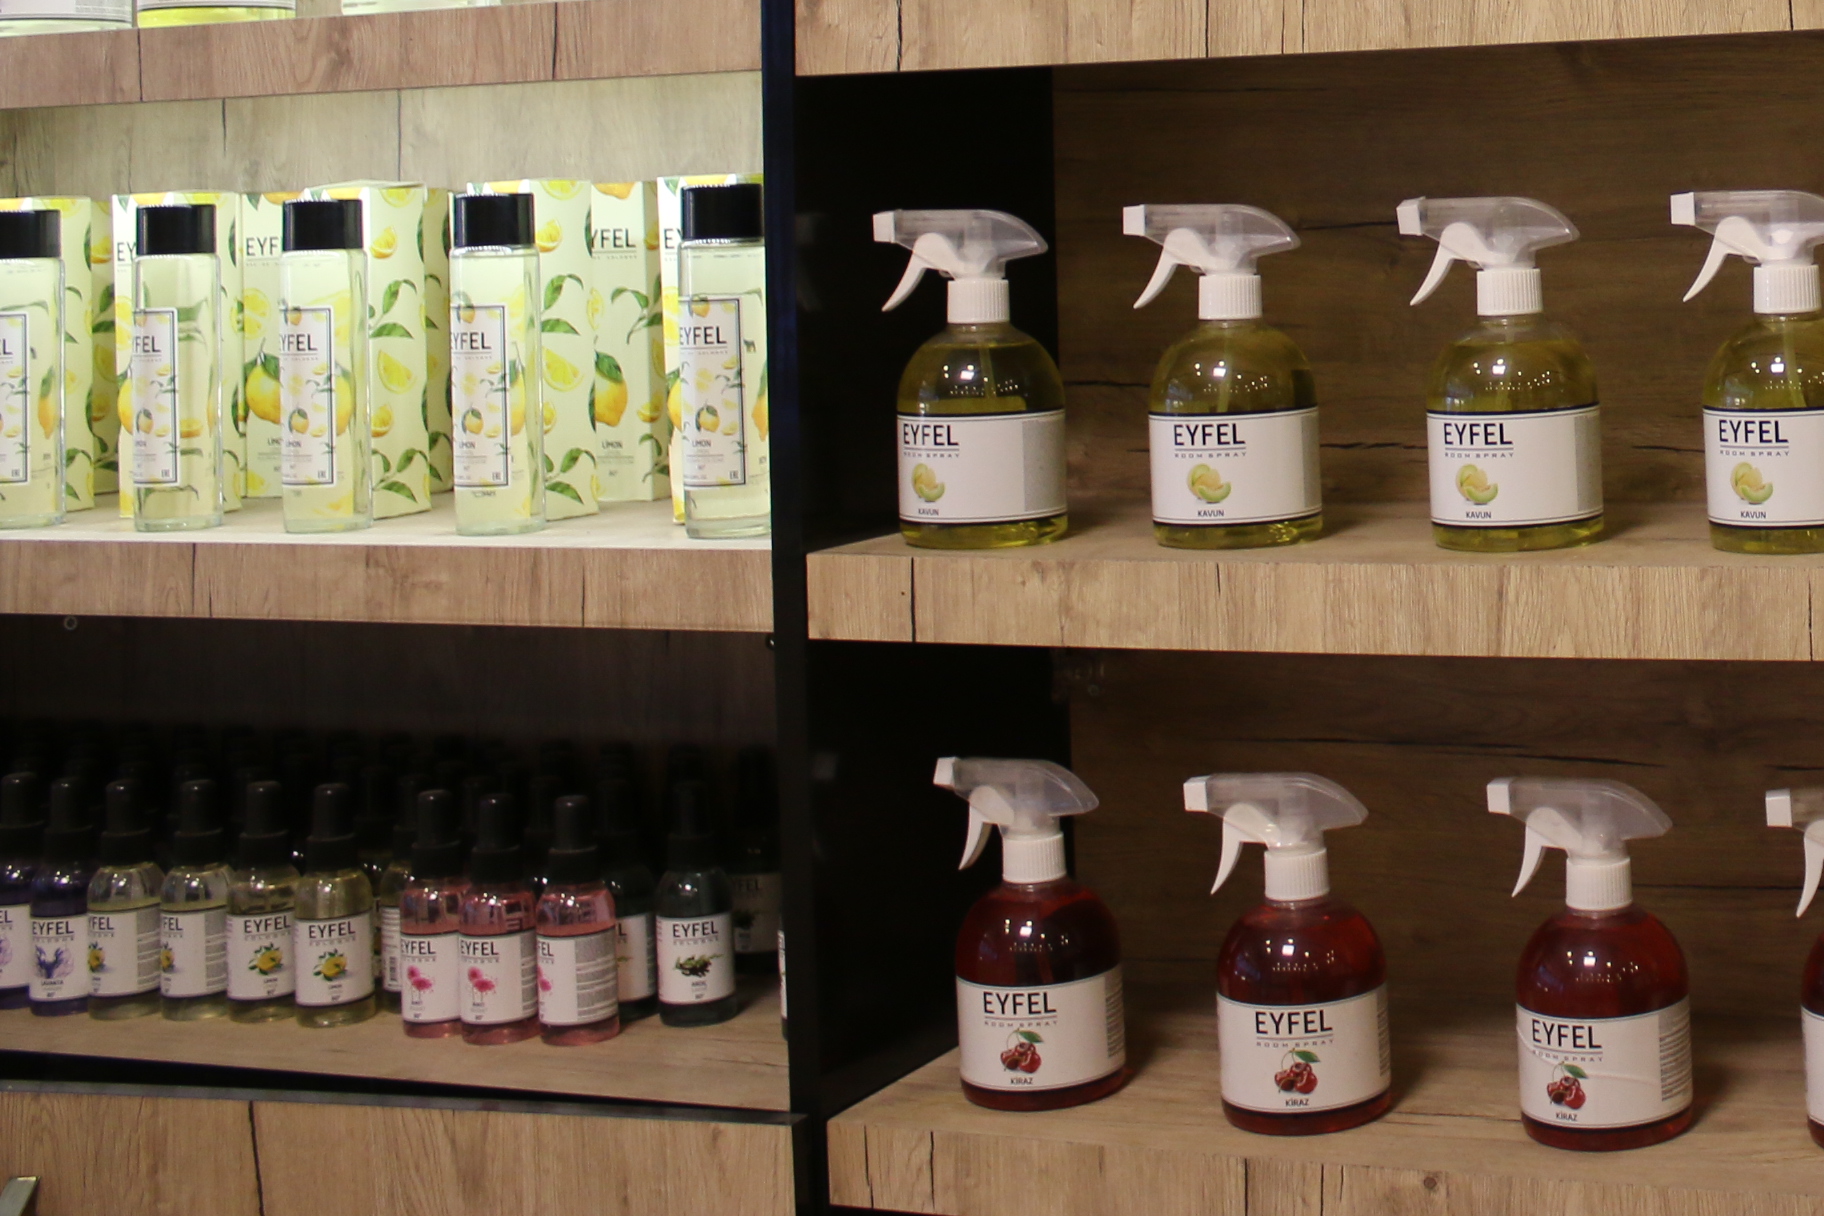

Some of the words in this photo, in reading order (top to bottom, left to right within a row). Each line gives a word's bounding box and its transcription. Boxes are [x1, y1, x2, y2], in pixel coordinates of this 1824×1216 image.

[246, 235, 280, 257] EYF
[590, 228, 636, 248] YFEL
[280, 333, 318, 351] YFEL
[903, 424, 959, 445] EYFEL
[1174, 423, 1246, 446] EYFEL
[1444, 422, 1513, 445] EYFEL
[1719, 419, 1789, 443] EYFEL
[1197, 509, 1224, 518] KAVUN
[1465, 510, 1492, 519] KAVUN
[1740, 510, 1766, 519] KAVUN
[32, 920, 74, 936] EYFEL
[244, 915, 291, 934] EYFEL
[308, 921, 355, 939] EYFEL
[672, 921, 718, 938] EYFEL
[983, 991, 1057, 1016] EYFEL
[1255, 1009, 1333, 1036] EYFEL
[1532, 1019, 1602, 1049] EYFEL
